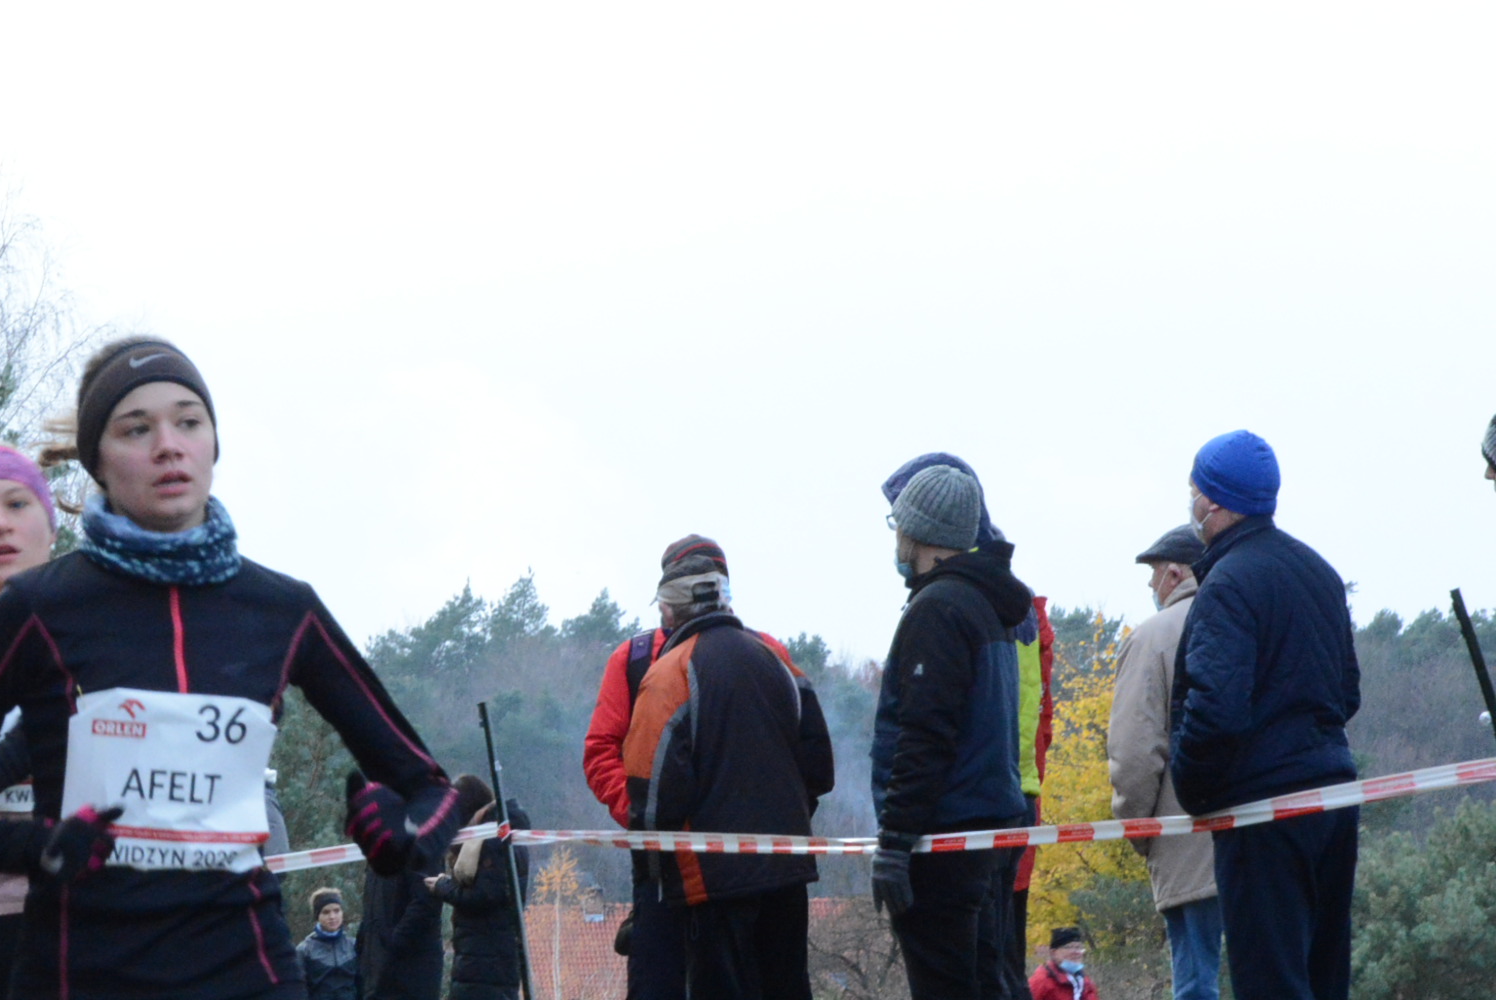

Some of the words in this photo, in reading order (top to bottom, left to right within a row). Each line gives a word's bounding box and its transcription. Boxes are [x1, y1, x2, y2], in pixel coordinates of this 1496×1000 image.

[94, 720, 145, 737] ORLEN
[196, 704, 247, 744] 36
[121, 768, 222, 804] AFELT
[110, 845, 186, 865] WIDZYN
